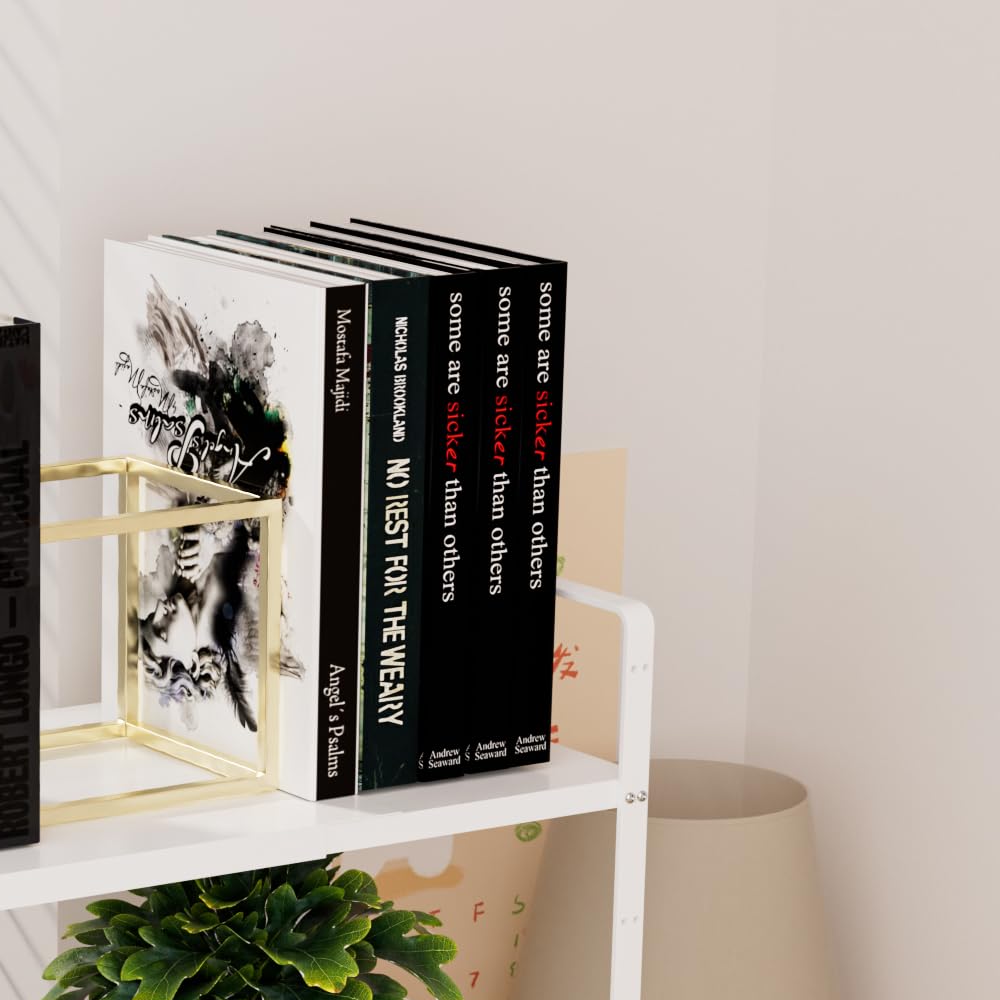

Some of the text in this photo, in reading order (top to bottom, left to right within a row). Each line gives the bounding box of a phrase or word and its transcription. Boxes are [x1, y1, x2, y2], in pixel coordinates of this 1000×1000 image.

[330, 308, 352, 413] Mostafa Majidi
[393, 316, 408, 443] NICHOLAS BROOKLAND
[490, 286, 513, 596] some are sicker than others
[530, 282, 552, 590] some are sicker than others
[442, 292, 464, 602] some are sicker than others
[378, 458, 410, 726] NO REST FOR THE WEARY
[476, 740, 506, 752] Andrew
[514, 742, 547, 754] Seaward
[516, 734, 546, 745] Andrew
[328, 724, 345, 778] Psalms
[430, 748, 460, 760] Andrew
[474, 748, 507, 762] Seaward
[428, 756, 461, 769] Seaward
[473, 902, 485, 922] F
[469, 971, 479, 988] 7
